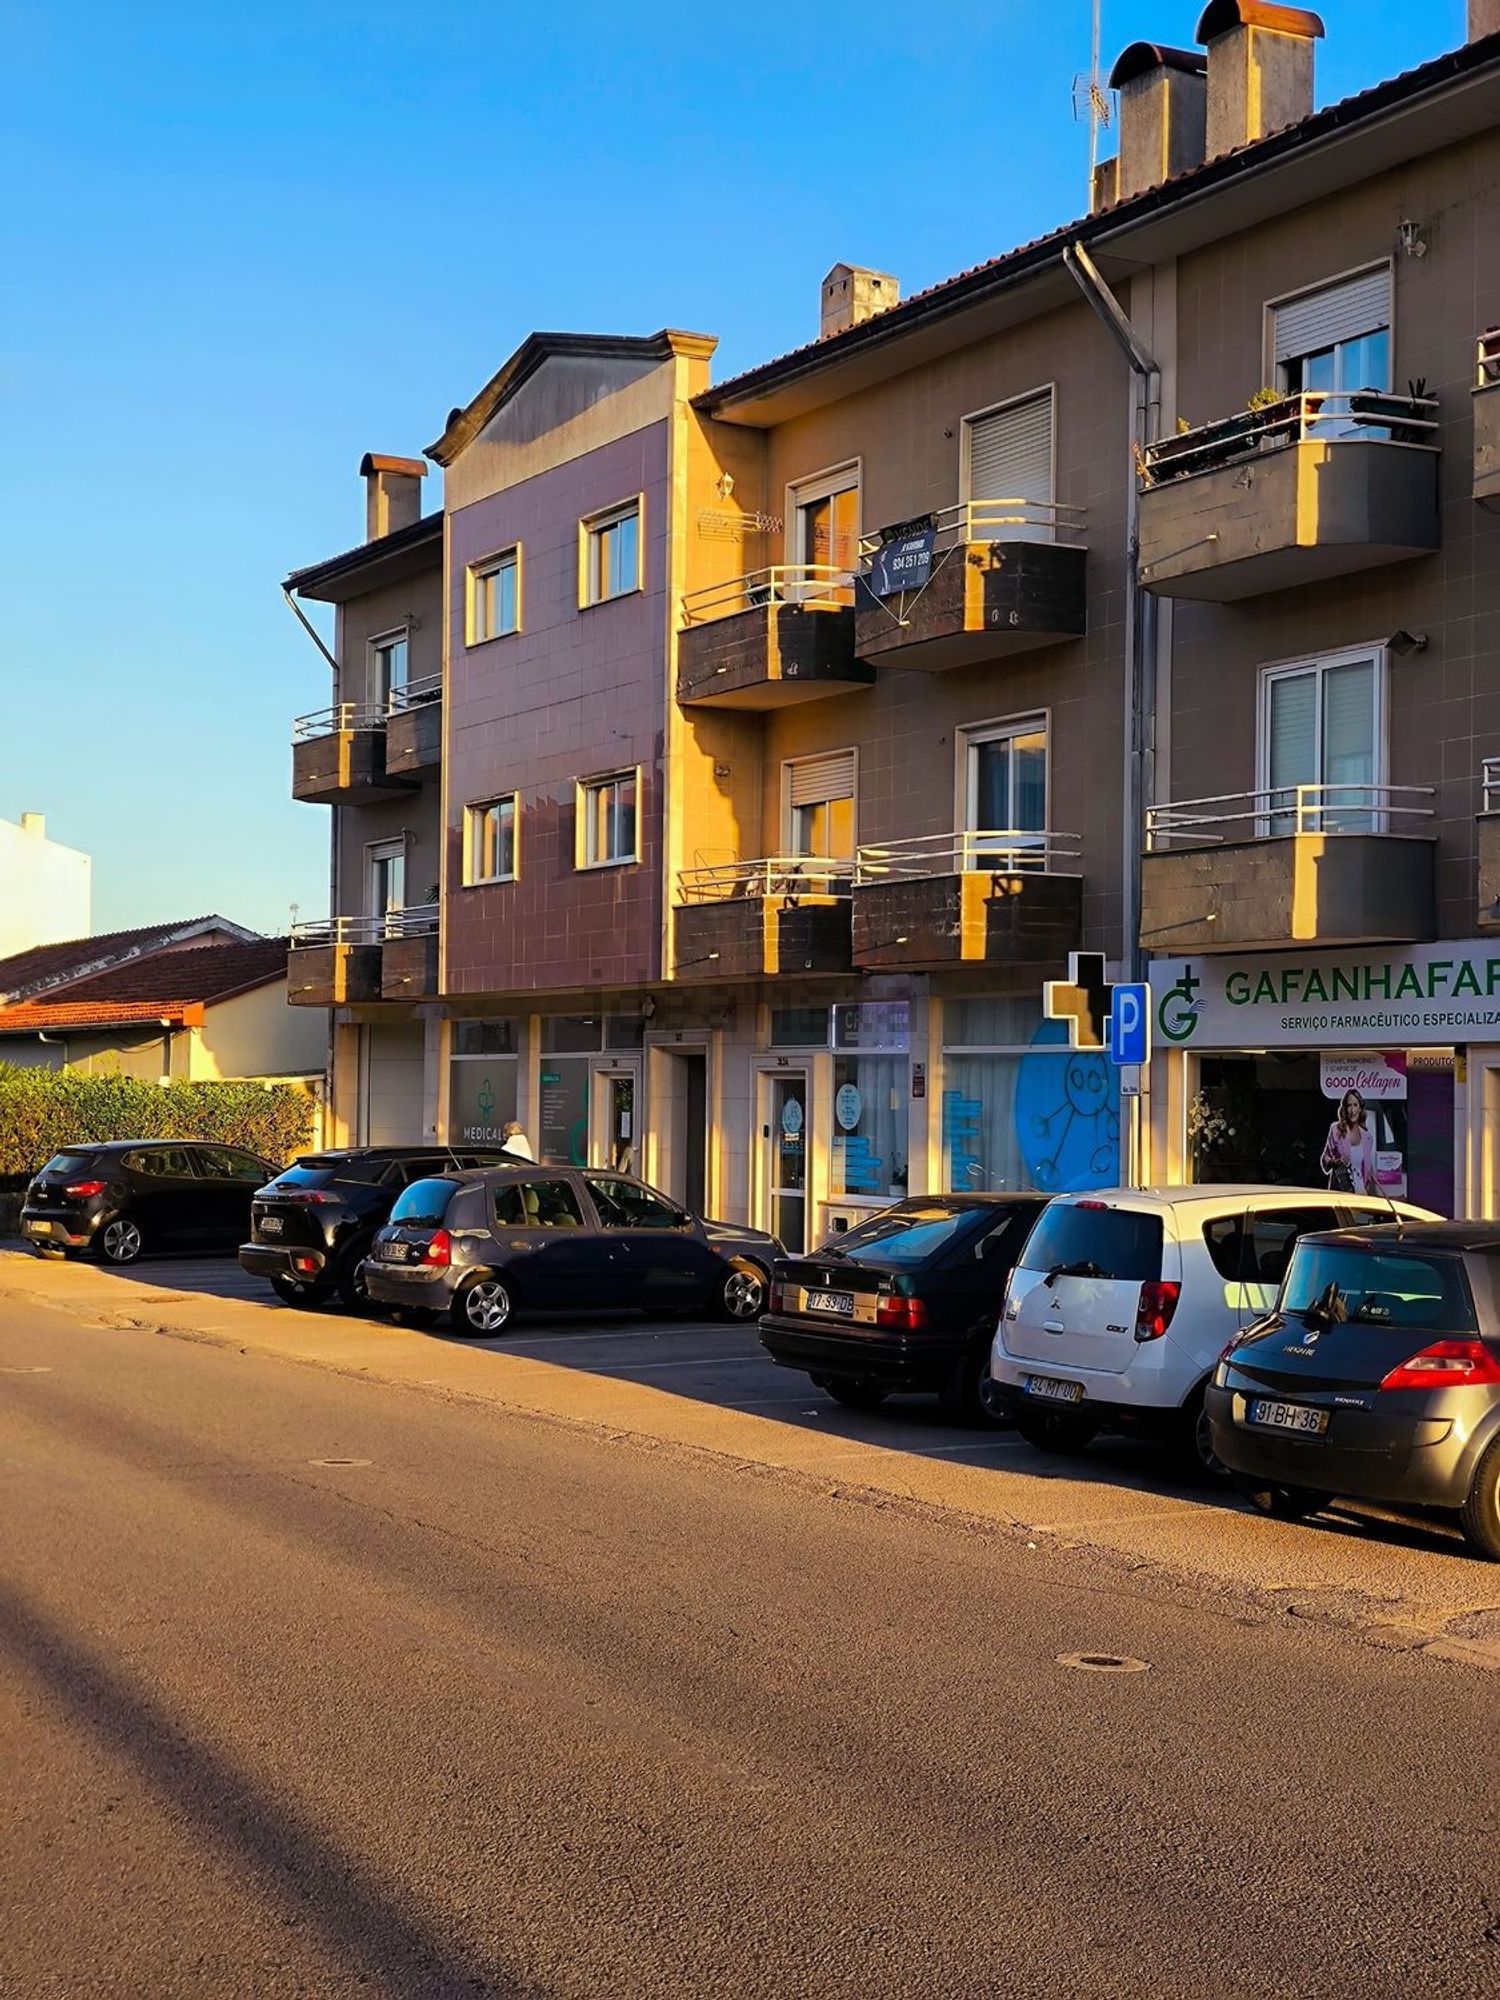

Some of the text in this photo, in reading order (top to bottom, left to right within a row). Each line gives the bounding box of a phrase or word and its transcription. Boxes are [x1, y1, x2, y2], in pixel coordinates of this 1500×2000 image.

[1119, 993, 1139, 1056] P
[1281, 1016, 1328, 1031] SERVIÇO
[1325, 1070, 1401, 1095] GOOD Collagen
[1106, 1324, 1128, 1333] COLT
